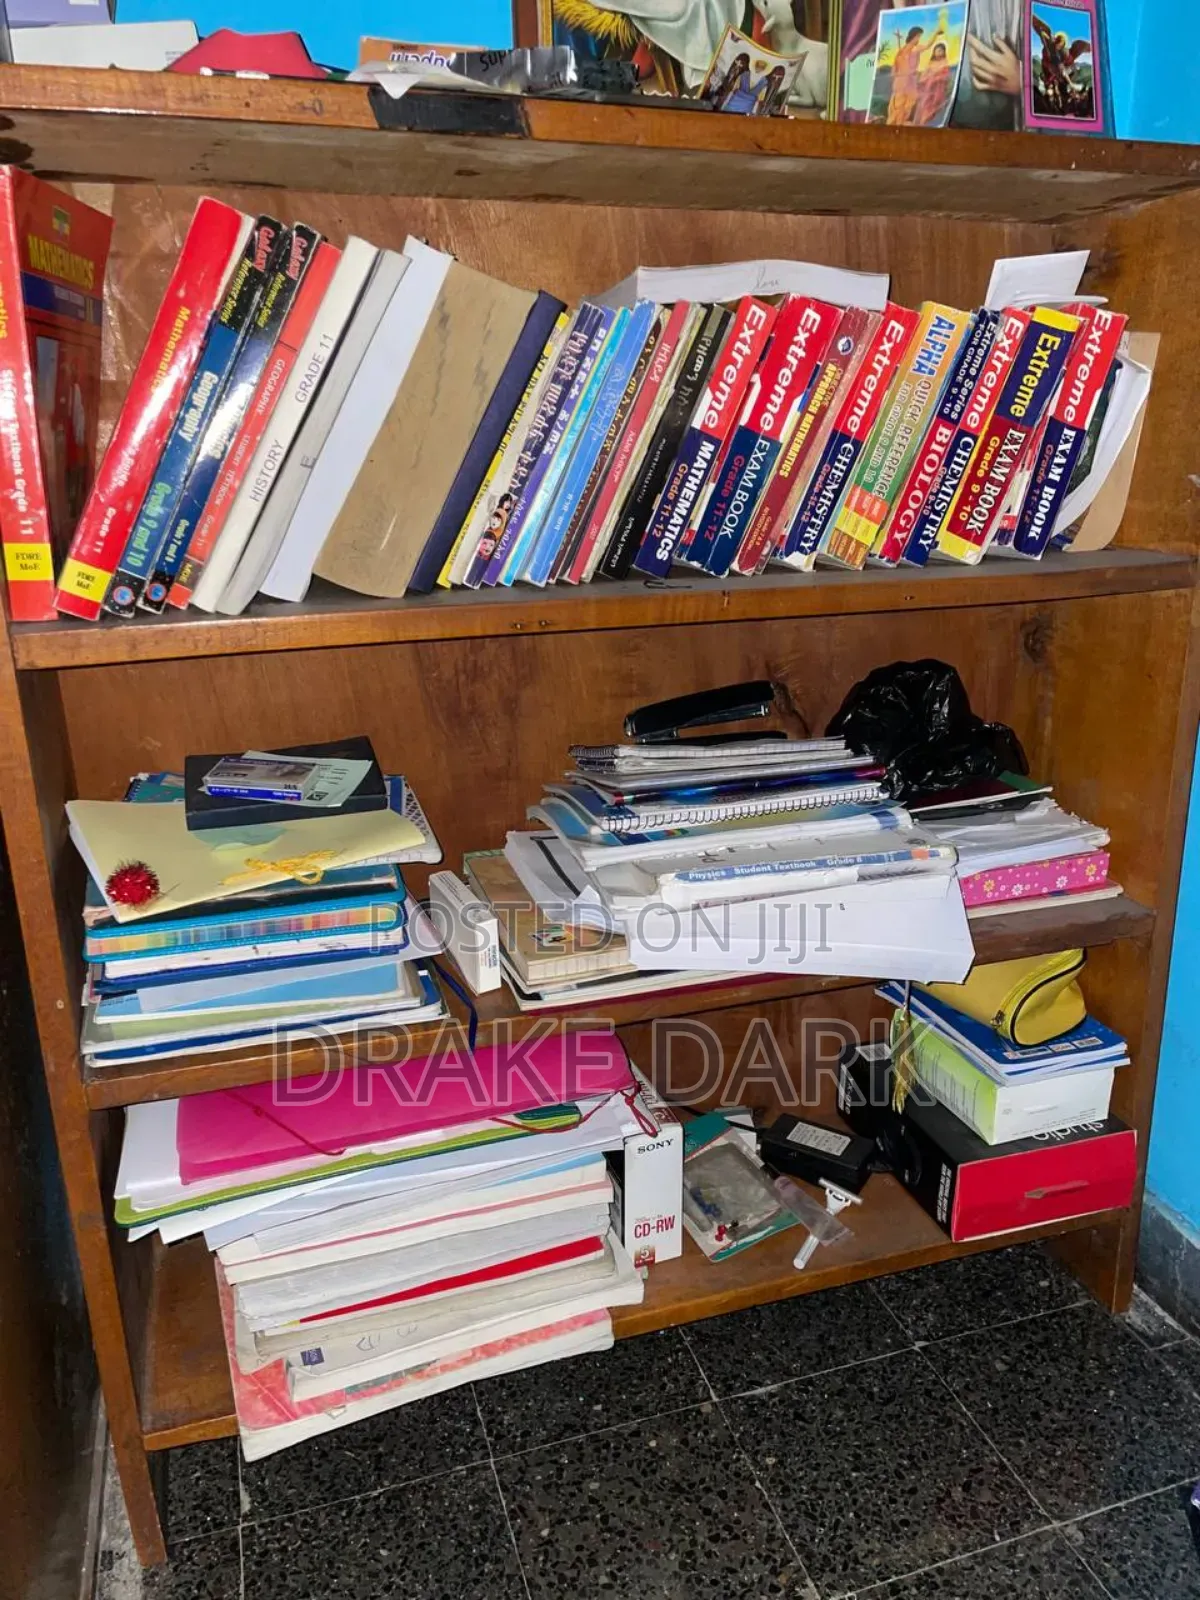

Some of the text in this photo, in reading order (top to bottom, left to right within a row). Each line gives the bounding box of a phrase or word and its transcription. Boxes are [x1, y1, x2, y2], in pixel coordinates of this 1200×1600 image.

[251, 224, 274, 272] Galaxy
[285, 235, 306, 280] Galaxy
[218, 257, 253, 324] Reference Series
[254, 271, 287, 329] Reference Series
[149, 305, 191, 394] Mathematics
[910, 314, 957, 380] ALPHA
[969, 322, 985, 346] FOR
[253, 357, 287, 415] GEOGRAPHY
[701, 302, 769, 430] Extreme
[756, 305, 823, 433] Extreme
[819, 366, 844, 408] OBJECTIVE
[844, 318, 906, 434] Extreme
[948, 320, 998, 421] Extreme Series
[954, 346, 975, 383] GRADE
[965, 315, 1026, 429] Extreme
[1008, 330, 1061, 419] Extreme
[1060, 308, 1113, 423] Extreme
[176, 370, 219, 443] Geography
[894, 380, 912, 402] FOR
[250, 334, 333, 502] HISTORY GRADE 11
[777, 362, 837, 478] APPROACH MATHEMATICS
[871, 377, 933, 499] QUICK REFERENCE
[881, 402, 903, 436] GRADE
[9, 423, 24, 475] Textbook
[230, 432, 251, 466] STUDENT
[869, 444, 886, 466] AND
[975, 434, 1001, 479] Grade
[1034, 443, 1055, 484] Grade
[14, 478, 28, 512] Grade
[211, 468, 236, 506] TEXTBOOK
[665, 461, 689, 501] Grade
[718, 453, 745, 498] Grade
[718, 437, 770, 539] EXAM BOOK
[796, 440, 856, 556] CHEMISTRY
[813, 462, 831, 493] Grade
[889, 423, 953, 548] BIOLOGY
[915, 434, 976, 551] CHEMISTRY
[929, 464, 948, 494] Grade
[964, 427, 1026, 536] EXAM BOOK
[969, 482, 981, 494] 9
[1026, 426, 1077, 541] EXAM BOOK
[125, 480, 173, 568] Grade 9 and 10
[654, 439, 716, 562] MATHEMATICS
[760, 514, 773, 533] Grade
[957, 502, 973, 522] 10
[19, 519, 34, 535] 11
[91, 506, 117, 554] Grade 11
[173, 517, 190, 539] Grade
[19, 562, 41, 571] MoE
[179, 562, 194, 584] MOE
[688, 869, 727, 881] Physics
[733, 864, 771, 876] Student
[773, 860, 817, 871] Textbook
[826, 857, 855, 867] Grade
[637, 1139, 674, 1155] SONY
[634, 1214, 676, 1239] CD-RW
